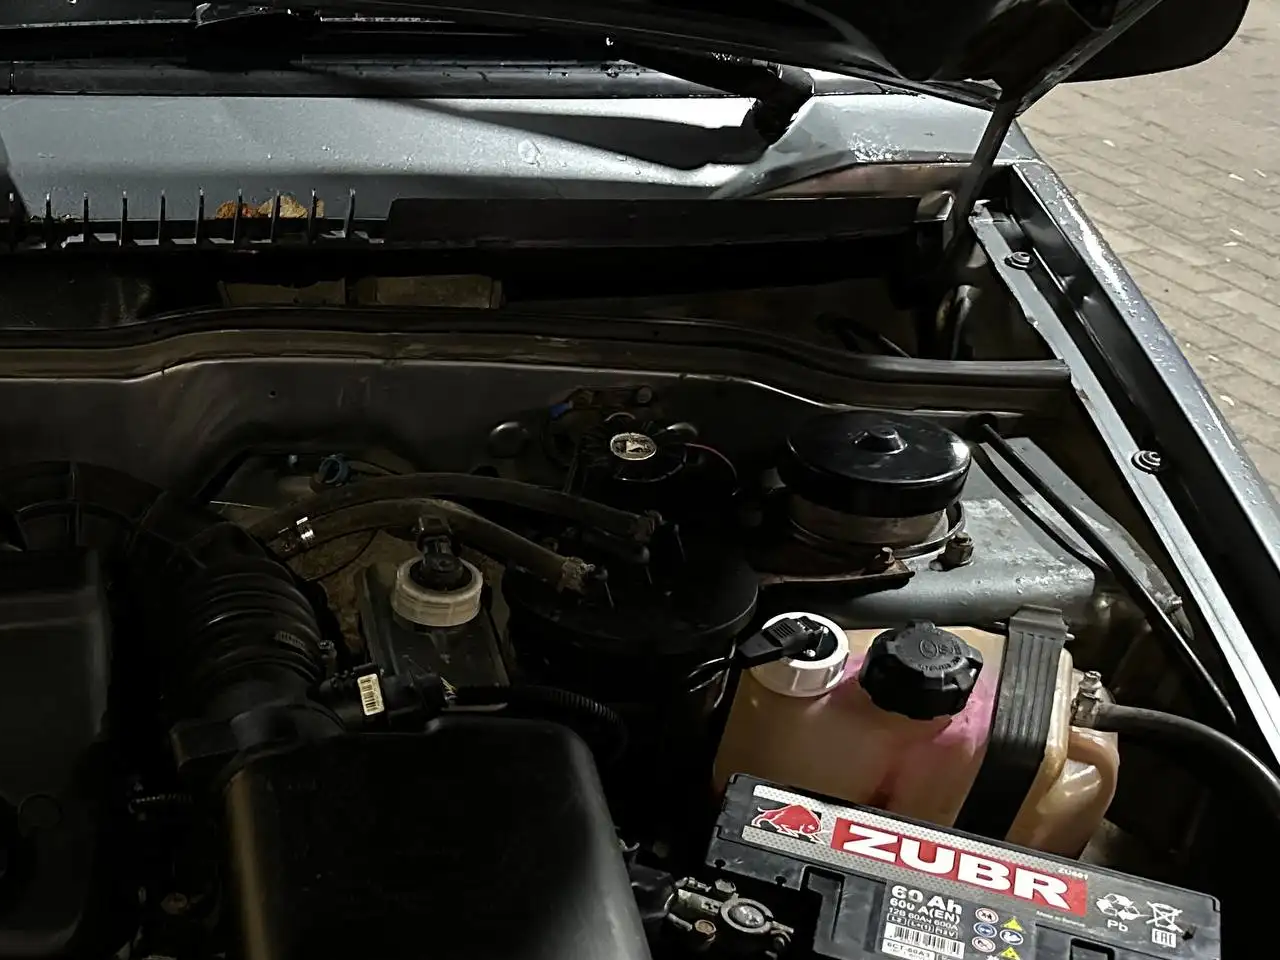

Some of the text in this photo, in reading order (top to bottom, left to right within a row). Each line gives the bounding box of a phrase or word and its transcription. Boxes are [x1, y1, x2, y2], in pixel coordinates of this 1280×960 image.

[842, 823, 1072, 911] ZUBR
[889, 897, 961, 925] 600 A(EN)
[891, 885, 963, 915] 60 Ah
[1107, 919, 1129, 932] Pb
